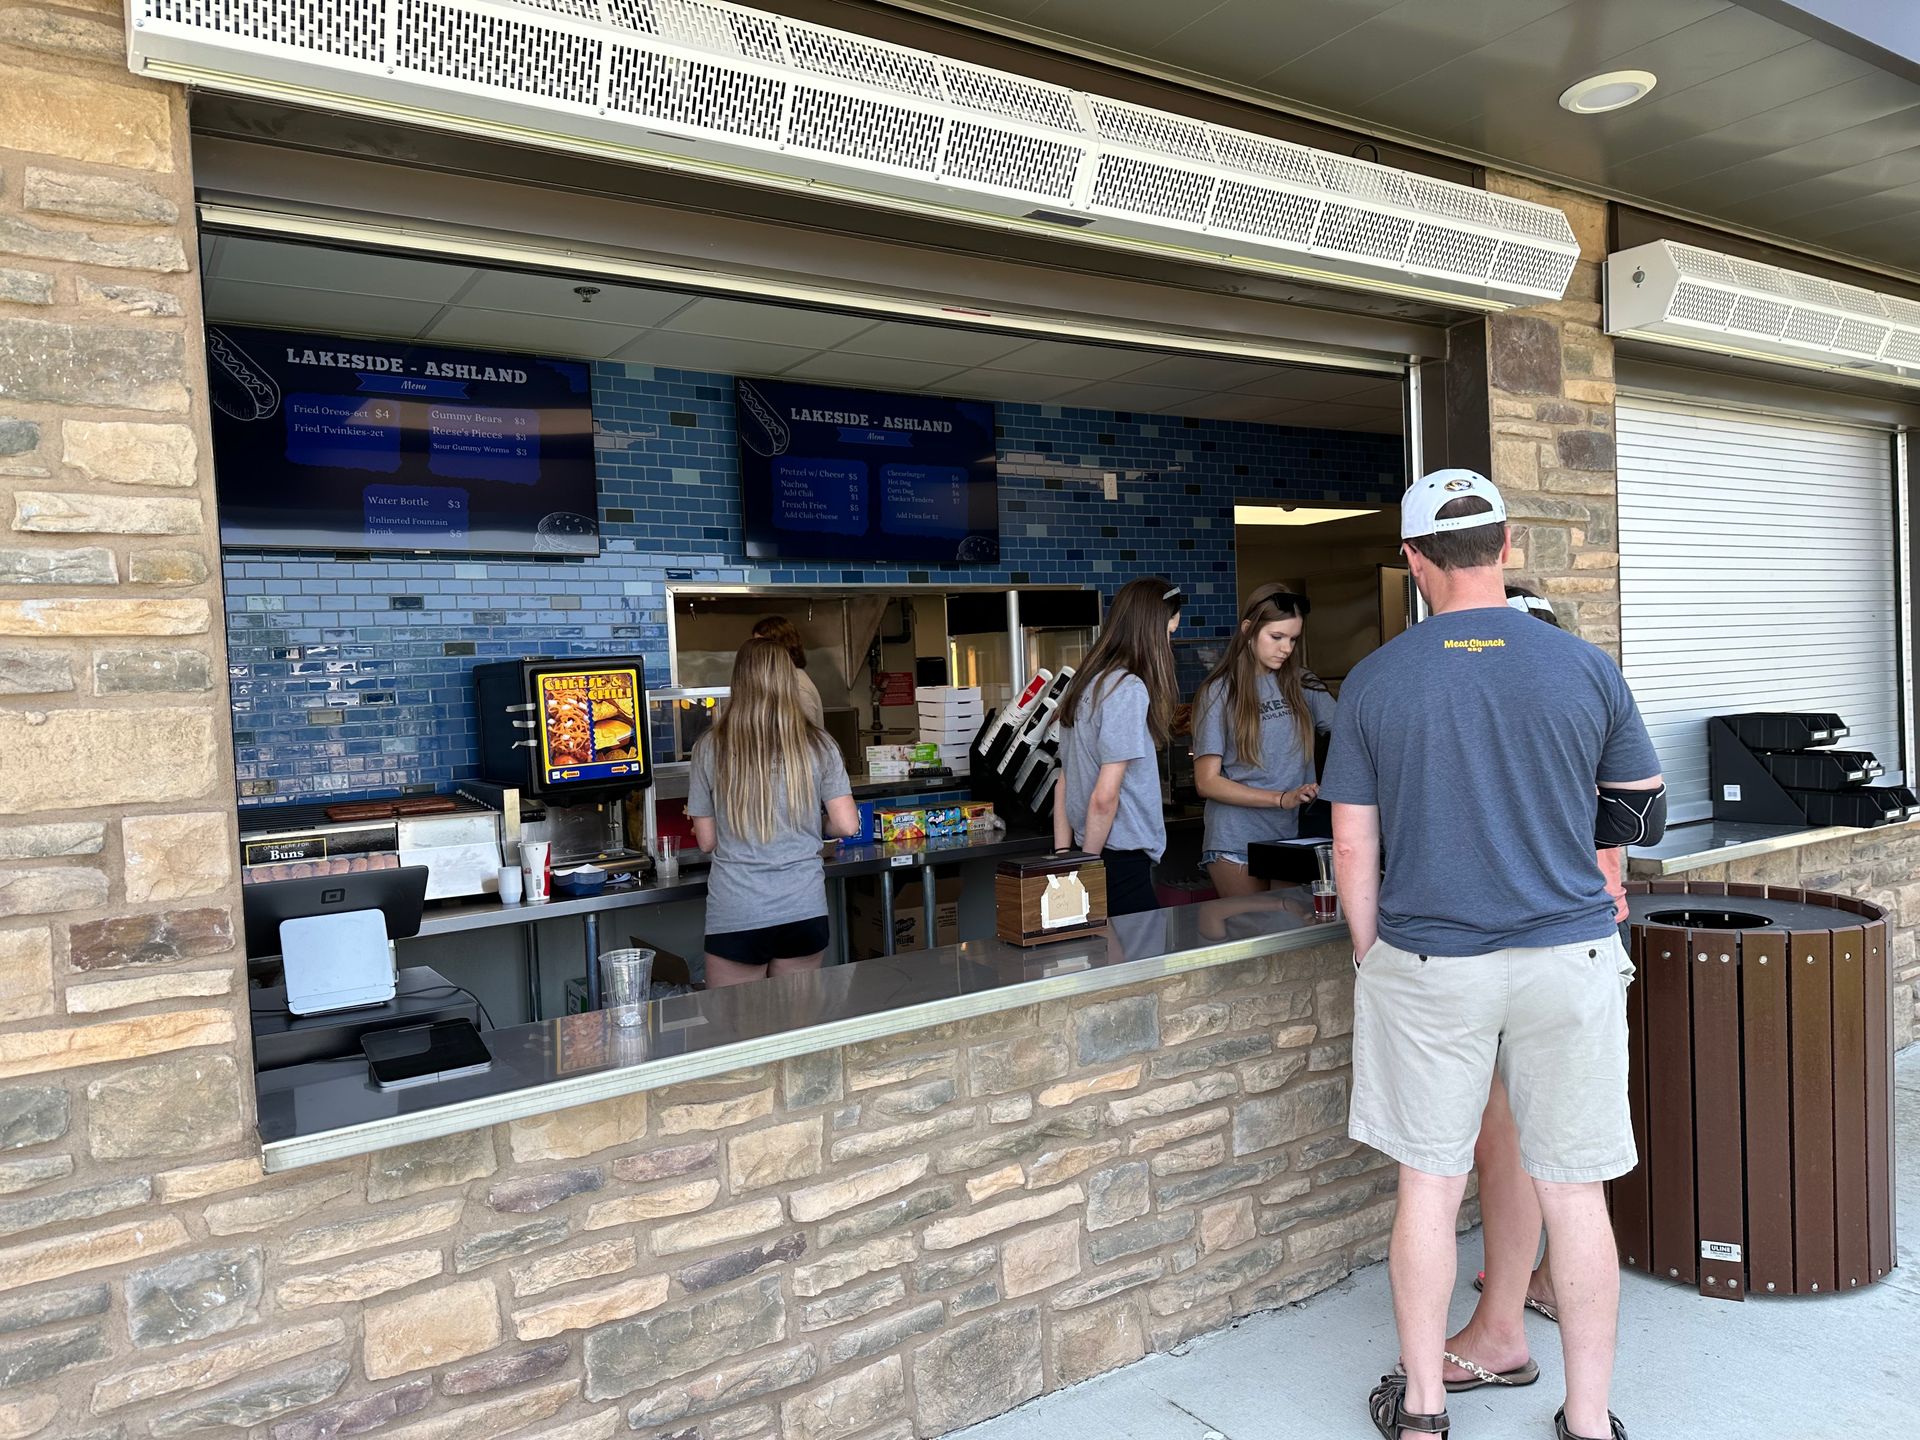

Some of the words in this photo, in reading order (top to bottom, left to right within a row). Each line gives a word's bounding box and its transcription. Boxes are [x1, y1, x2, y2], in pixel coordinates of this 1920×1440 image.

[287, 348, 404, 373] LAKESIDE
[424, 361, 528, 384] ASHLAND
[400, 380, 427, 391] Menu
[293, 404, 320, 415] Fried
[321, 406, 369, 418] Oreos-6ct
[375, 408, 390, 420] $4
[431, 410, 472, 423] Gummy
[474, 412, 503, 424] Bears
[514, 416, 526, 425] $3
[790, 408, 870, 426] LAKESIDE
[883, 416, 952, 433] ASHLAND
[294, 423, 320, 434] Fried
[432, 426, 469, 437] Reese's
[471, 429, 503, 440] Pieces
[515, 432, 527, 441] $3
[433, 442, 450, 450] Sour
[452, 443, 481, 454] Gummy
[482, 445, 510, 454] Worms
[515, 447, 528, 456] $3
[780, 467, 807, 477] Pretzel
[819, 469, 845, 479] Cheese
[781, 479, 809, 489] Nachos
[368, 496, 399, 505] Water
[400, 497, 430, 507] Bottle
[447, 499, 461, 509] $3
[782, 500, 808, 510] French
[809, 501, 828, 510] Fries
[369, 516, 411, 526] Unlimited
[412, 517, 449, 527] Fountain
[370, 527, 394, 536] Drink
[1443, 639, 1469, 649] Meat
[1469, 638, 1506, 648] Church
[544, 676, 606, 691] CHEESE
[611, 676, 622, 688] &
[588, 687, 633, 700] CHILI
[270, 850, 305, 861] Buns
